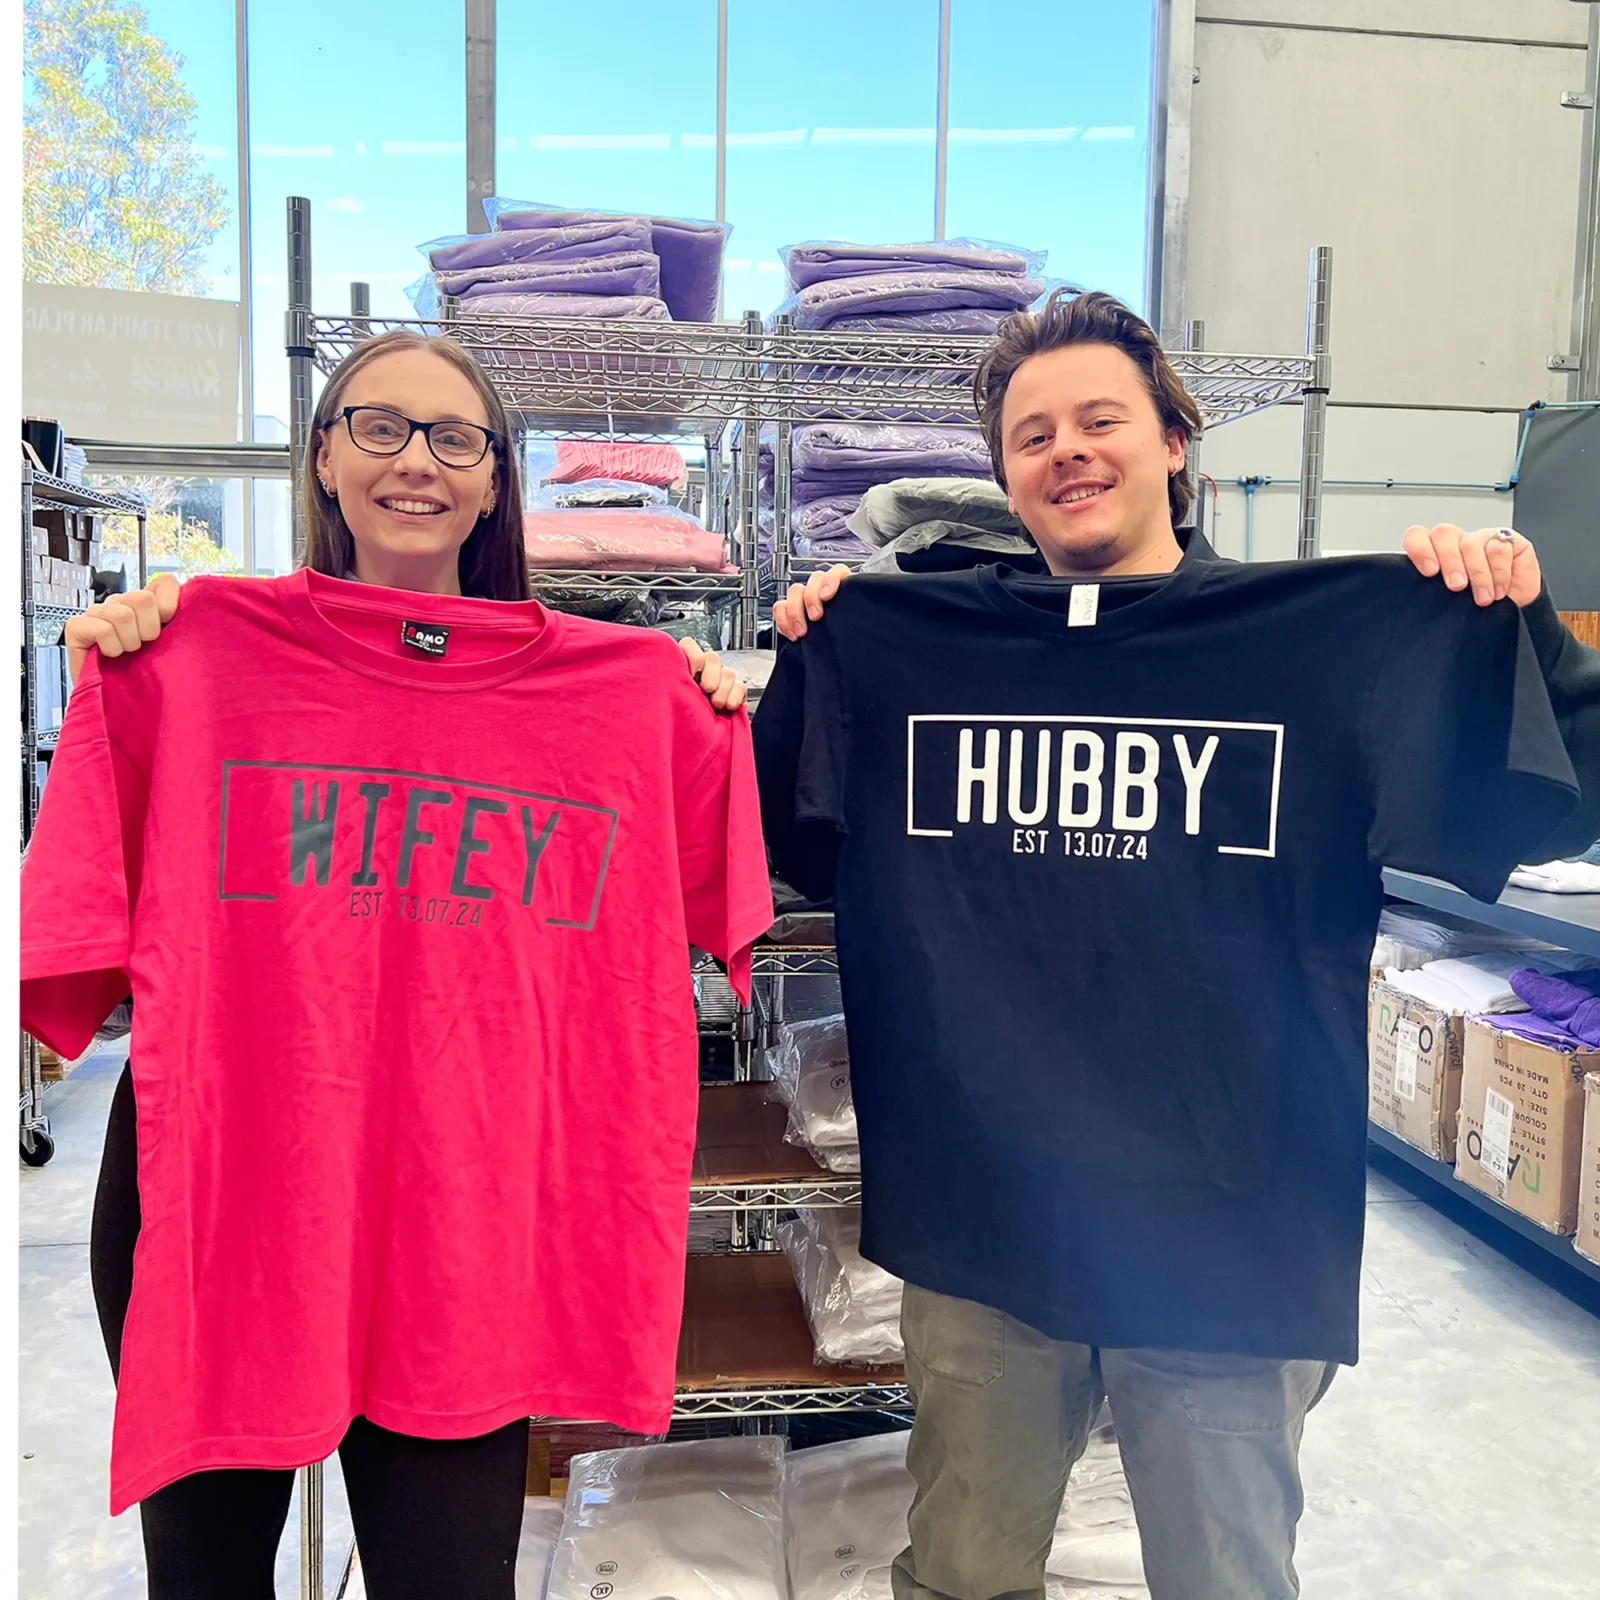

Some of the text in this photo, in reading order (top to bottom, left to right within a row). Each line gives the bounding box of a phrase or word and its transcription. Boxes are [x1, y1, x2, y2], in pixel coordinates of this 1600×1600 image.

[956, 728, 1220, 836] HUBBY
[289, 779, 560, 906] WIFEY
[1012, 828, 1148, 860] EST 13.07.24
[350, 892, 482, 928] EST 13.07.24
[1493, 1057, 1549, 1084] MADE IN CHINA
[1499, 1075, 1513, 1087] PCS
[1529, 1086, 1549, 1100] QTY:
[1527, 1102, 1548, 1115] SIZE:
[1519, 1128, 1547, 1146] STYLE:
[1535, 1151, 1546, 1160] BE
